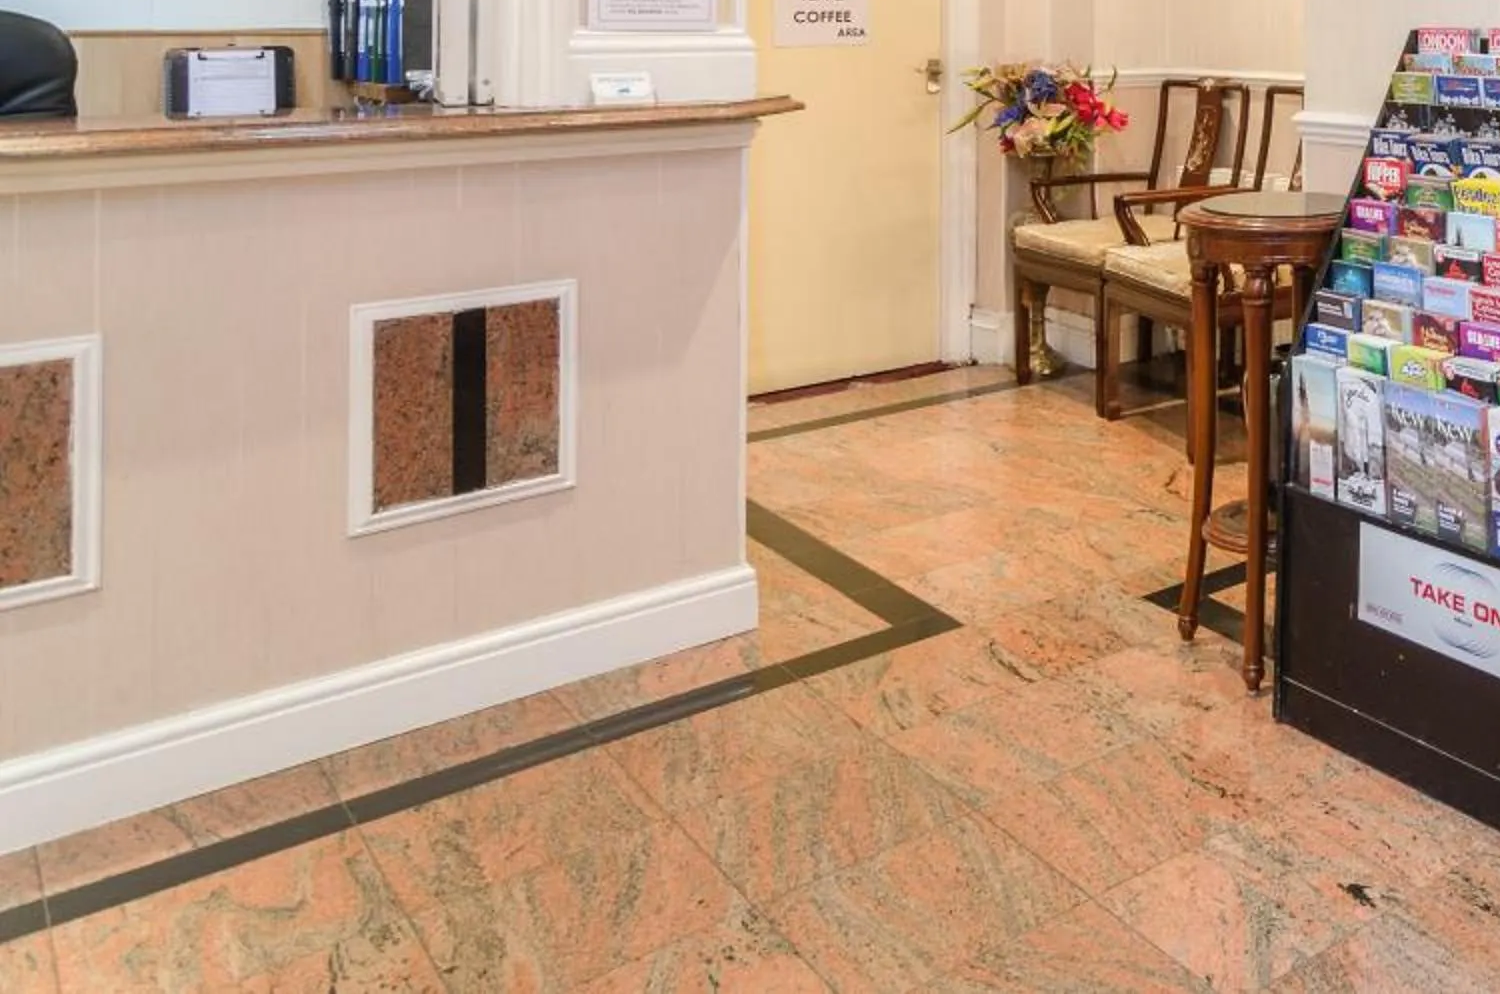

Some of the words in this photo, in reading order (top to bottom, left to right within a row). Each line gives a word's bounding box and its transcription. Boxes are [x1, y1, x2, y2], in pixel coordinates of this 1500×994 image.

[793, 10, 852, 24] COFFEE
[837, 28, 867, 38] AREA
[1419, 32, 1466, 49] LONDON
[1409, 576, 1465, 613] TAKE
